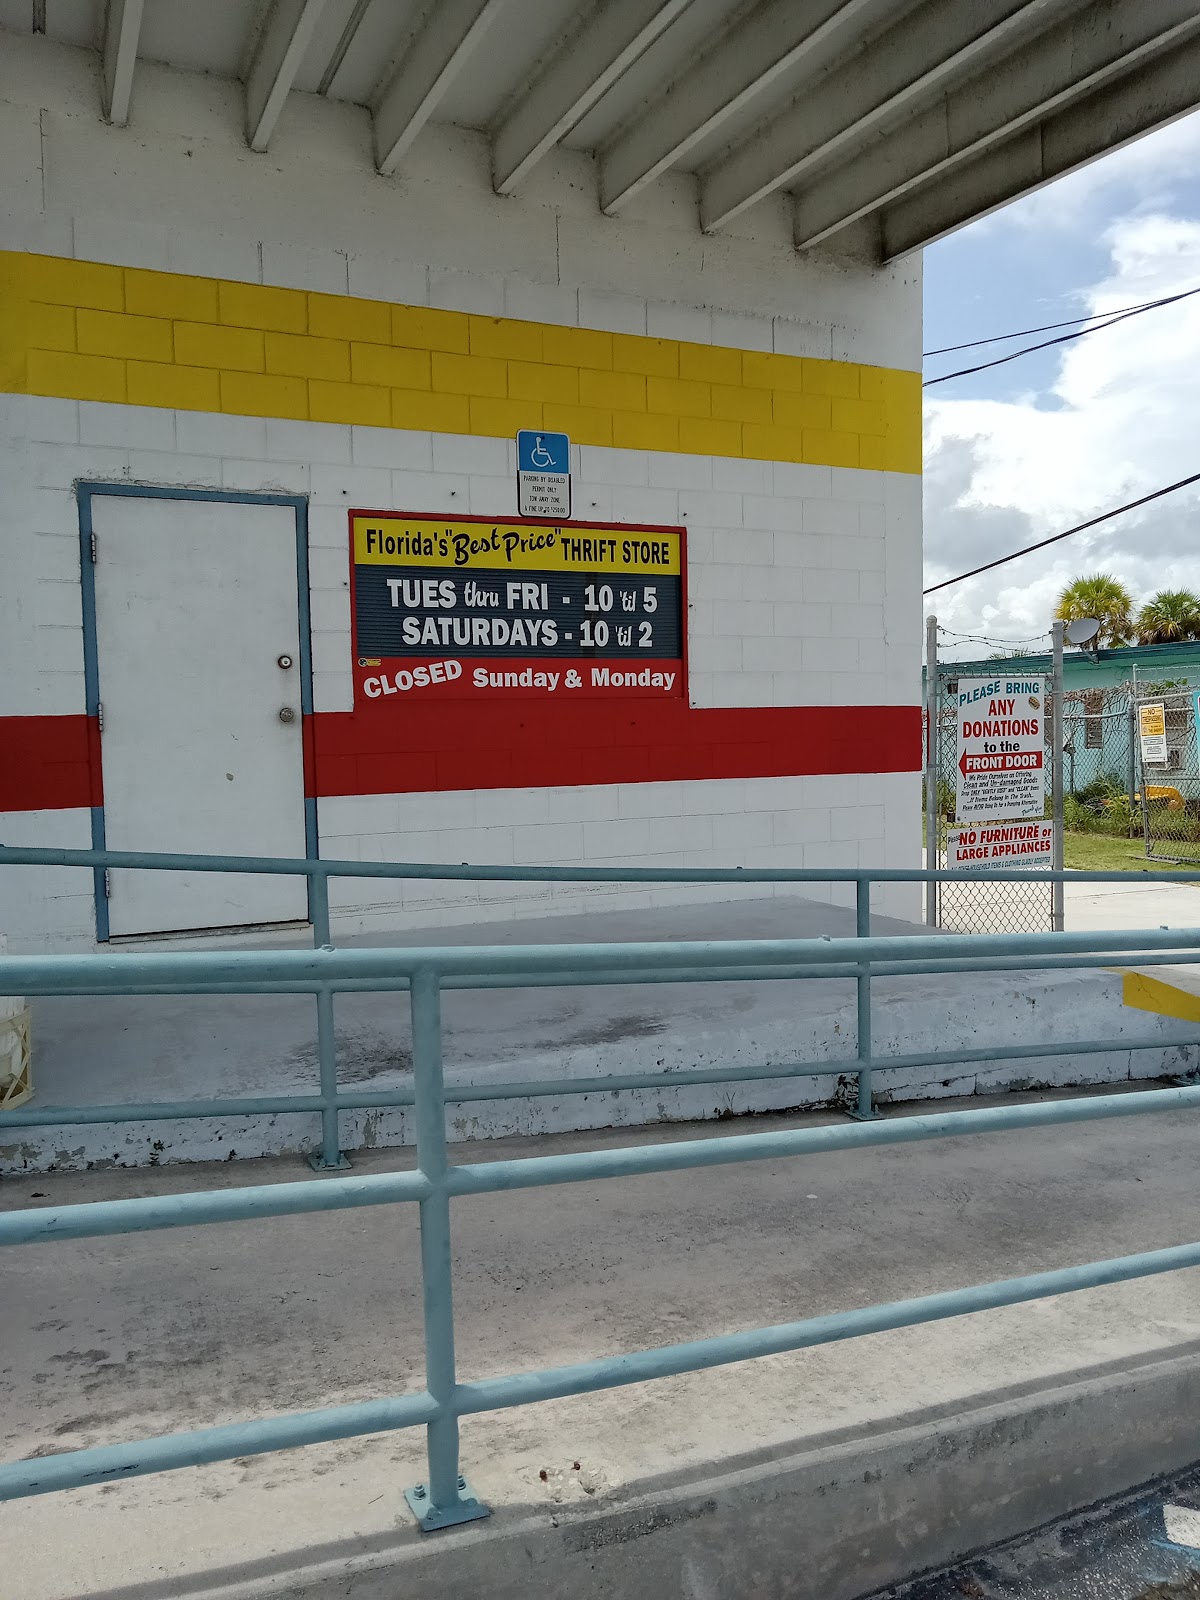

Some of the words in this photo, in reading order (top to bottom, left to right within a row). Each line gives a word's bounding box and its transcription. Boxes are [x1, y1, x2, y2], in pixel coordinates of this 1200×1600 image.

[366, 529, 448, 556] Florida's
[561, 537, 617, 562] THRIFT
[622, 541, 670, 565] STORE
[387, 579, 456, 608] TUES
[464, 582, 499, 607] thru
[506, 582, 548, 610] FRI
[584, 585, 613, 611] 10
[643, 587, 658, 612] 5
[402, 617, 558, 646] SATURDAYS
[580, 621, 609, 647] 10
[639, 622, 653, 647] 2
[363, 660, 462, 698] CLOSED
[472, 668, 560, 691] Sunday
[566, 669, 582, 688] &
[591, 668, 676, 691] Monday
[959, 681, 1000, 707] PLEASE
[1006, 683, 1039, 693] BRING
[989, 699, 1015, 716] ANY
[963, 719, 1038, 738] DONATIONS
[984, 742, 996, 753] to
[1000, 741, 1020, 752] the
[966, 756, 1003, 770] FRONT
[1006, 755, 1037, 768] DOOR
[959, 832, 976, 845] NO
[980, 825, 1039, 843] FURNITURE
[957, 847, 988, 860] LARGE
[992, 840, 1050, 857] APPLIANCES
